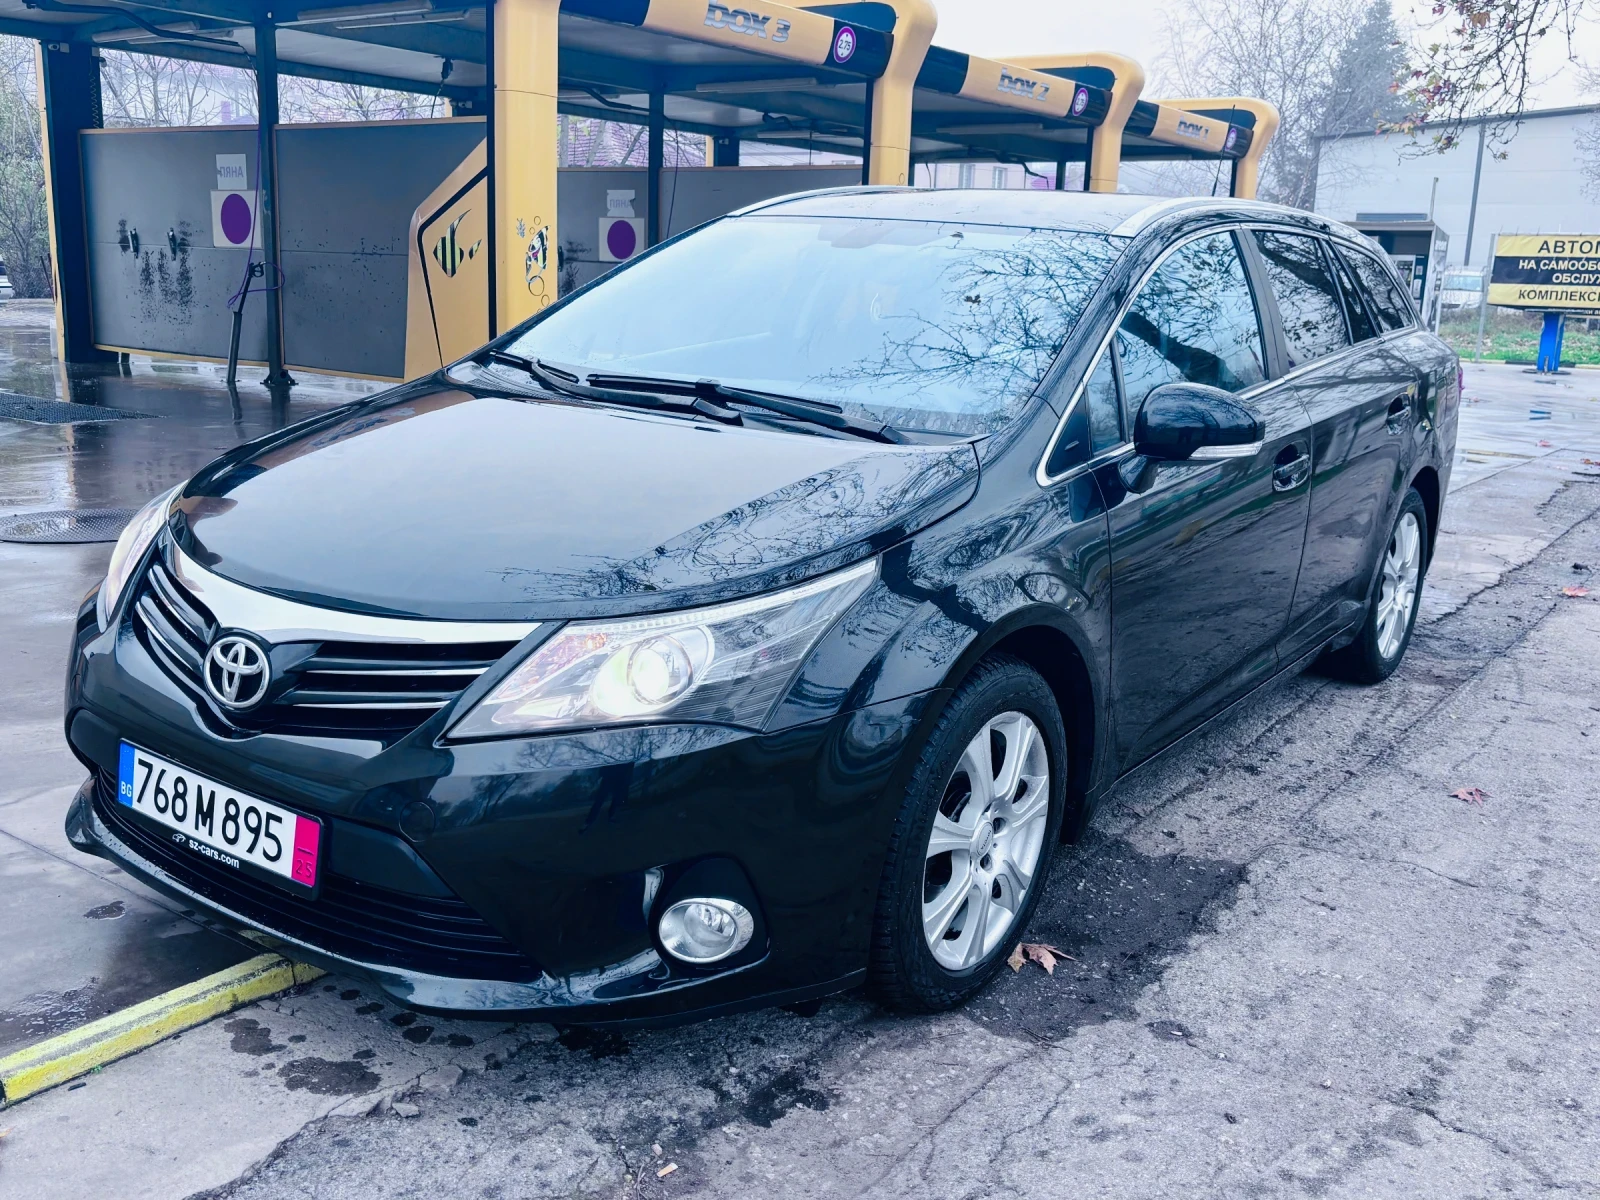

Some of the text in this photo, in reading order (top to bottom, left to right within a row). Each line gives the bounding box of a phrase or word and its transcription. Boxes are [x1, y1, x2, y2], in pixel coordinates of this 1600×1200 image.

[704, 0, 791, 43] box 3
[838, 39, 851, 51] 2.75
[996, 67, 1050, 102] box 2
[1175, 115, 1210, 142] box 1
[1518, 259, 1537, 270] НА
[121, 781, 132, 797] BG
[136, 758, 283, 863] 768 M 895
[188, 838, 240, 869] sz-cars.com
[296, 859, 313, 878] 25
